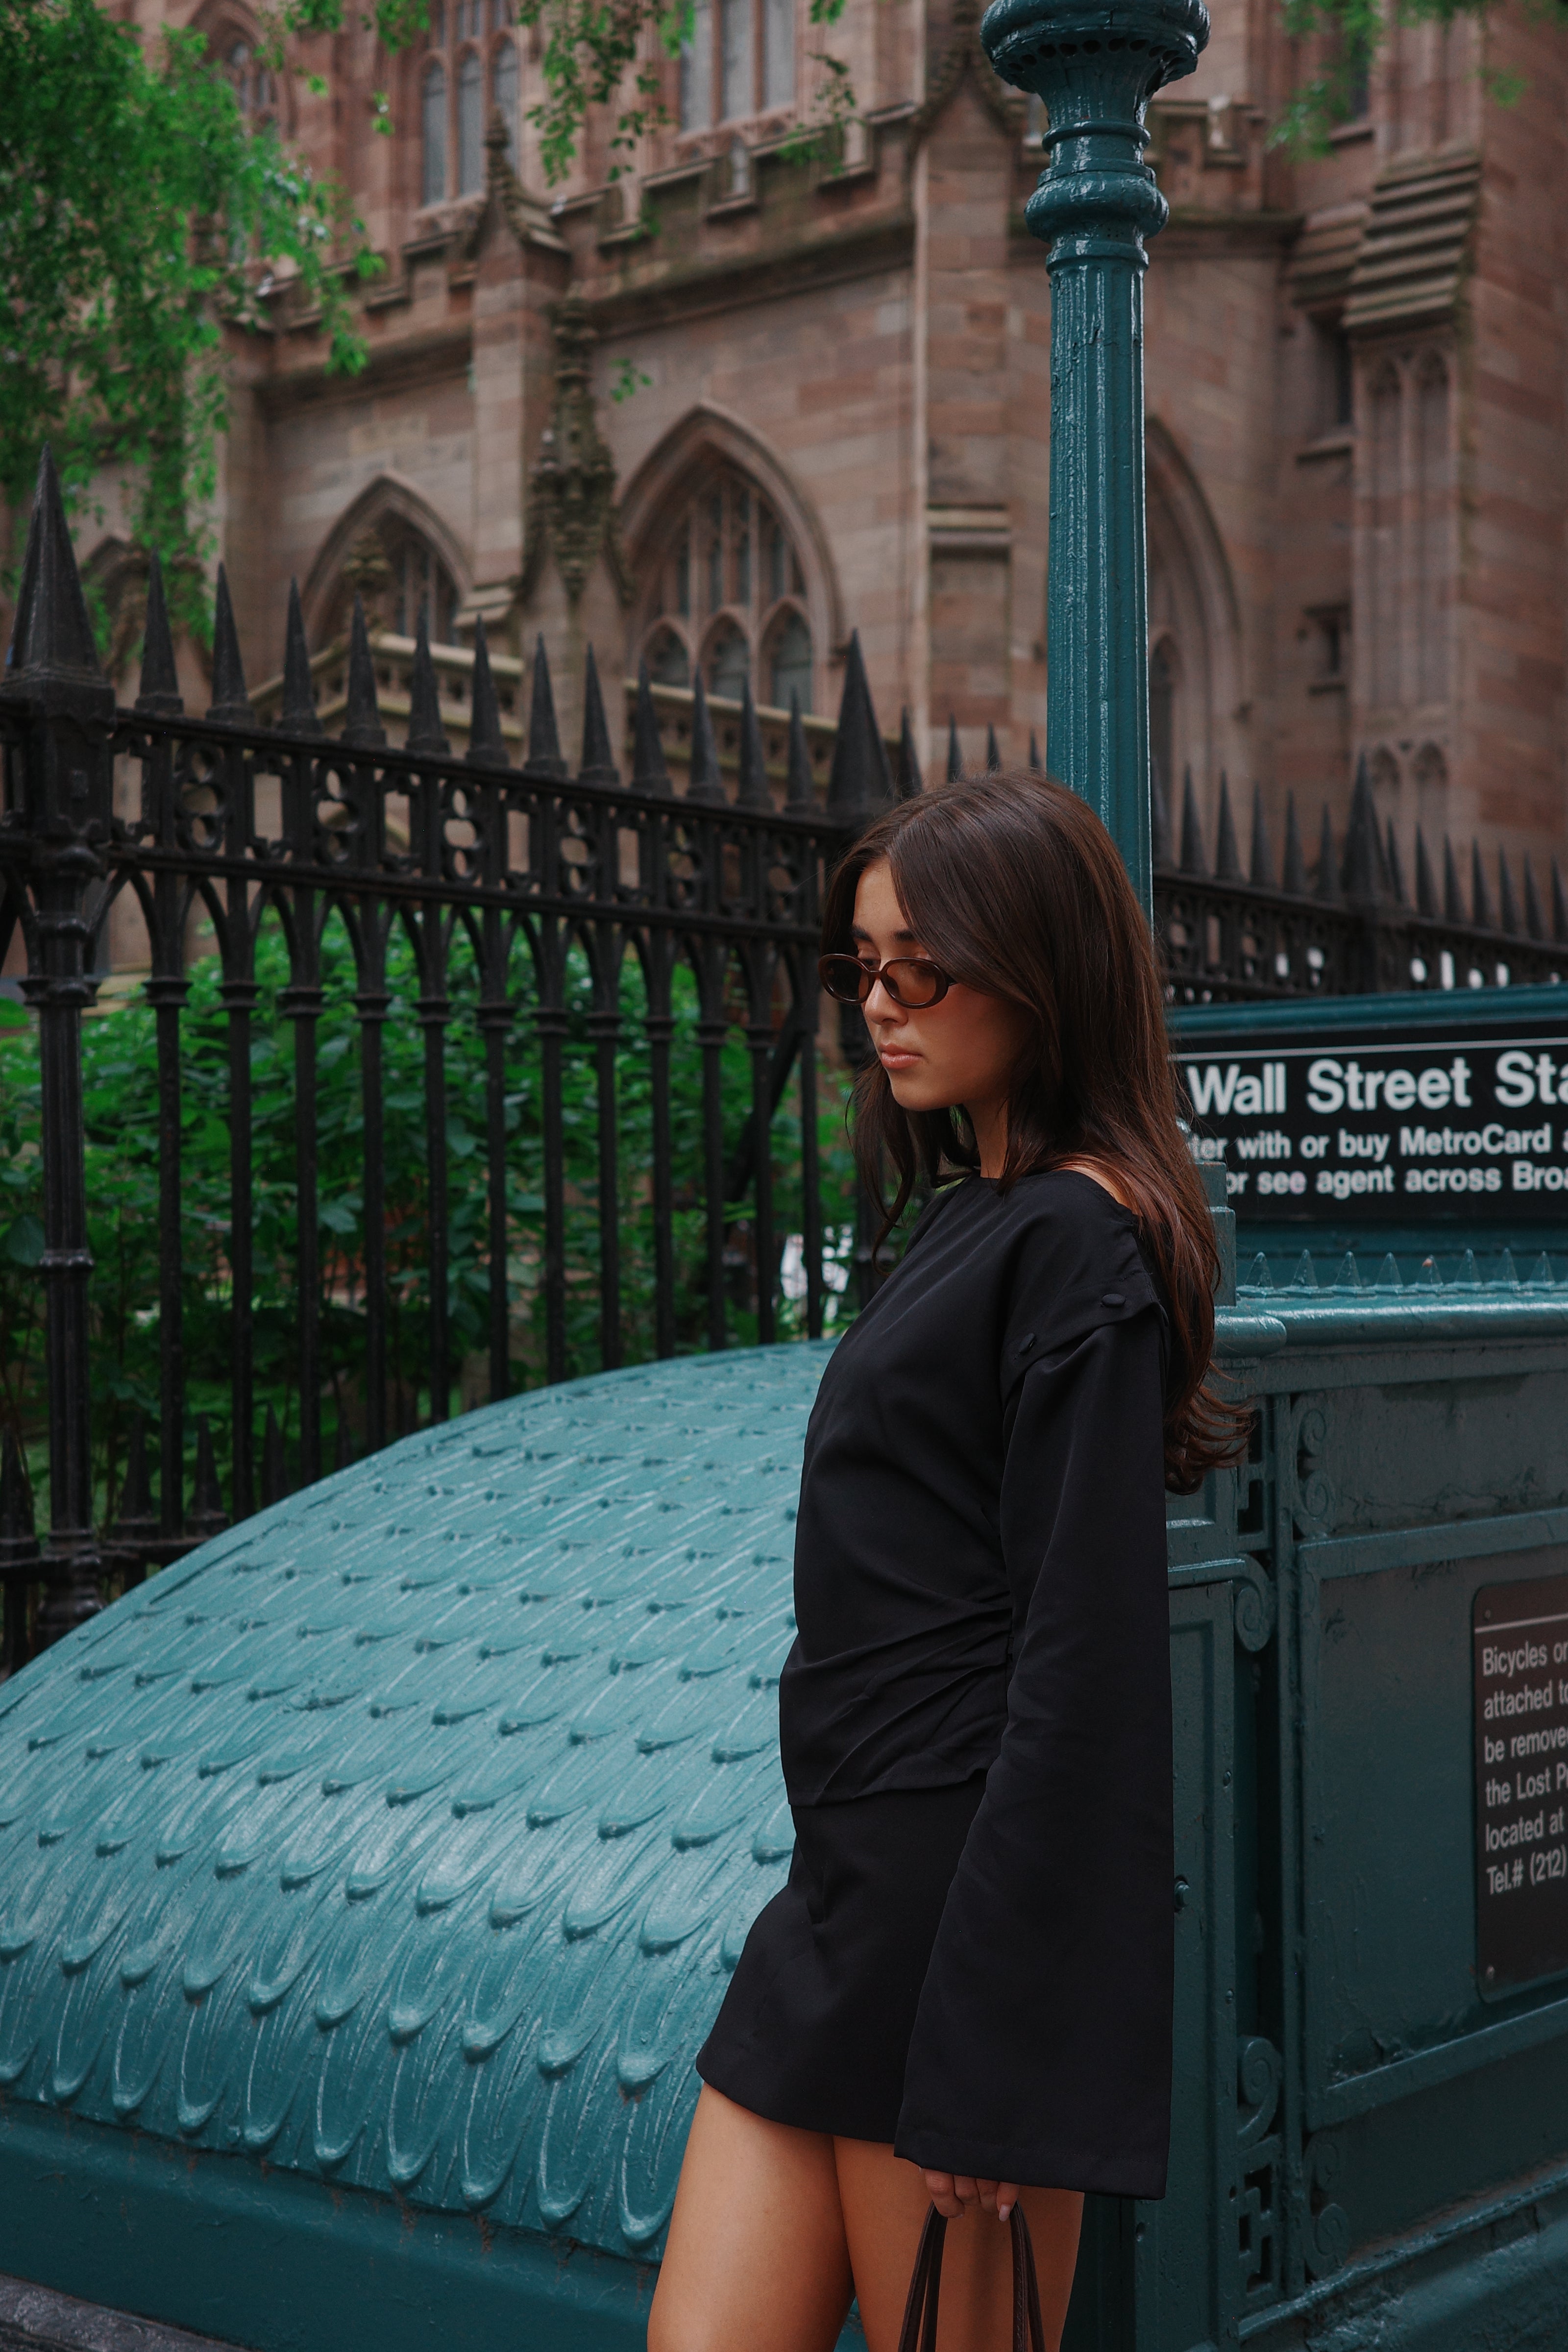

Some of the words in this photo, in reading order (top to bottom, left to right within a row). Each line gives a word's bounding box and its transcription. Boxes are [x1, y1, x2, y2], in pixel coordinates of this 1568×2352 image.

[1186, 1063, 1286, 1115] Wall
[1307, 1057, 1471, 1113] Street
[1237, 1130, 1291, 1158] with
[1300, 1136, 1329, 1158] or
[1339, 1129, 1390, 1162] buy
[1400, 1123, 1551, 1155] MetroCard
[1258, 1172, 1306, 1194] see
[1316, 1165, 1394, 1199] agent
[1405, 1168, 1501, 1192] across
[1513, 1161, 1568, 1190] Bro
[1483, 1641, 1547, 1677] Bicycles
[1484, 1680, 1553, 1719] attached
[1484, 1736, 1505, 1764] be
[1511, 1726, 1568, 1758] remove
[1486, 1778, 1511, 1807] the
[1517, 1767, 1551, 1800] Lost
[1556, 1762, 1568, 1790] P
[1486, 1810, 1544, 1851] located
[1549, 1807, 1564, 1835] at
[1486, 1858, 1523, 1894] Tel.#
[1530, 1844, 1567, 1886] (212)
